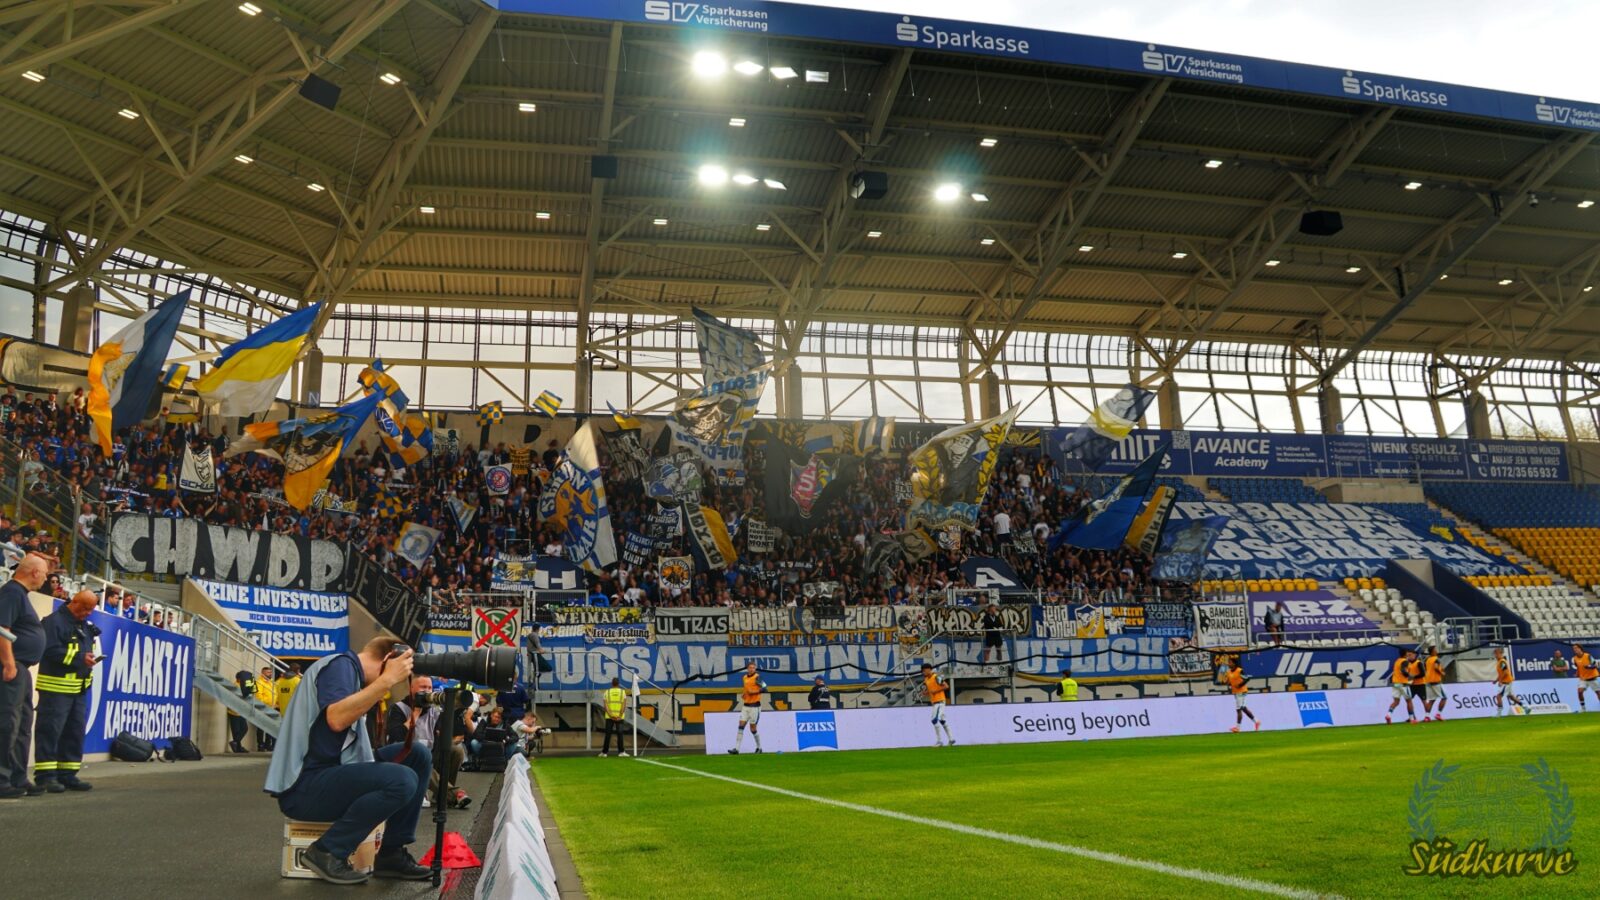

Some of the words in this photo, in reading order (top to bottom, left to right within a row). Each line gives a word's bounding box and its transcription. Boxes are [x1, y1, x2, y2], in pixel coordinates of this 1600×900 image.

[702, 4, 768, 19] Sparkassen
[695, 14, 768, 32] Versicherung
[922, 25, 1029, 54] Sparkasse
[1188, 57, 1242, 72] Sparkassen
[1184, 66, 1243, 84] Versicherung
[1363, 79, 1448, 106] Sparkasse
[1194, 437, 1270, 455] AVANCE
[1371, 442, 1409, 454] WENK
[1215, 456, 1268, 470] Academy
[490, 581, 534, 592] NAUMBURG
[196, 578, 249, 604] KEINE
[253, 586, 348, 613] INVESTOREN
[249, 613, 265, 621] HIER
[267, 614, 281, 623] UND
[282, 614, 313, 625] ÜBERALL
[554, 611, 620, 625] WEIMAR
[1209, 607, 1244, 617] BAMBULE
[656, 616, 729, 634] ULTRAS
[927, 606, 1030, 635] HARAIRI
[1209, 618, 1245, 630] RANDALE
[1253, 616, 1364, 626] Nzfahrzeuge
[617, 626, 650, 639] Festung
[107, 628, 174, 697] MARKT
[174, 643, 189, 699] 11
[743, 656, 781, 671] UND
[1516, 658, 1569, 673] Heinr
[1299, 700, 1329, 710] ZEISS
[1453, 692, 1502, 709] Seeing
[104, 700, 183, 741] KAFFEERÖSTEREI
[798, 722, 835, 732] ZEISS
[1012, 714, 1077, 735] Seeing
[1082, 709, 1151, 733] beyond
